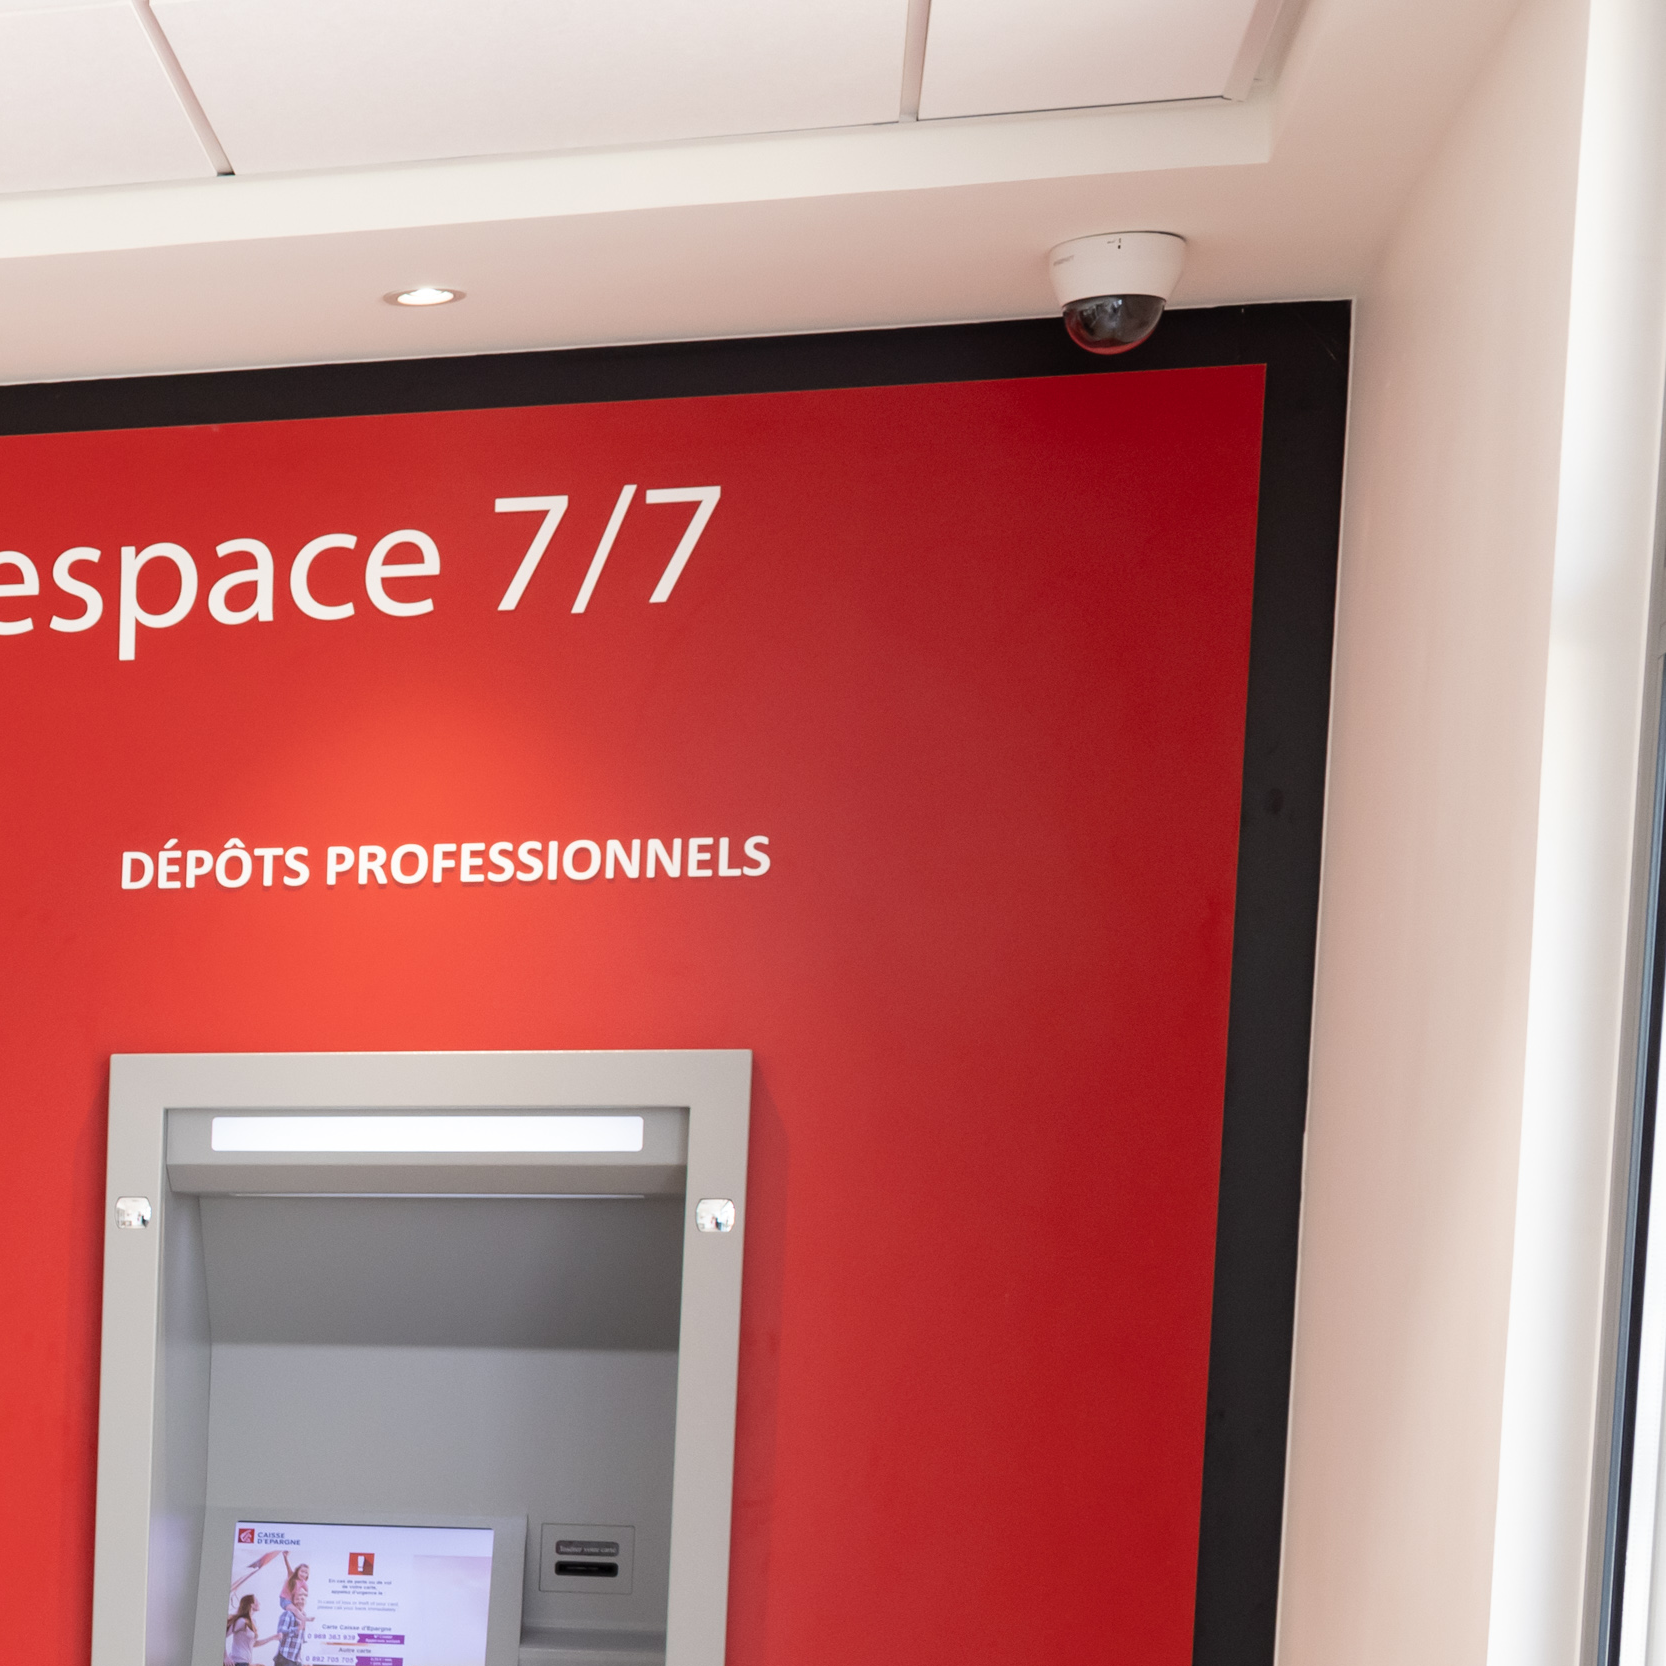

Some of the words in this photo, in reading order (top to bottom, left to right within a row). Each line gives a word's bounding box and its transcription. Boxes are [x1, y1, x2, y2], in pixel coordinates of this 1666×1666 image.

[494, 487, 722, 615] 7/7
[120, 838, 310, 890] DÉPÔTS
[326, 835, 771, 886] PROFESSIONNELS
[257, 1532, 285, 1540] CAISSE
[257, 1538, 301, 1546] D'EPARGNE
